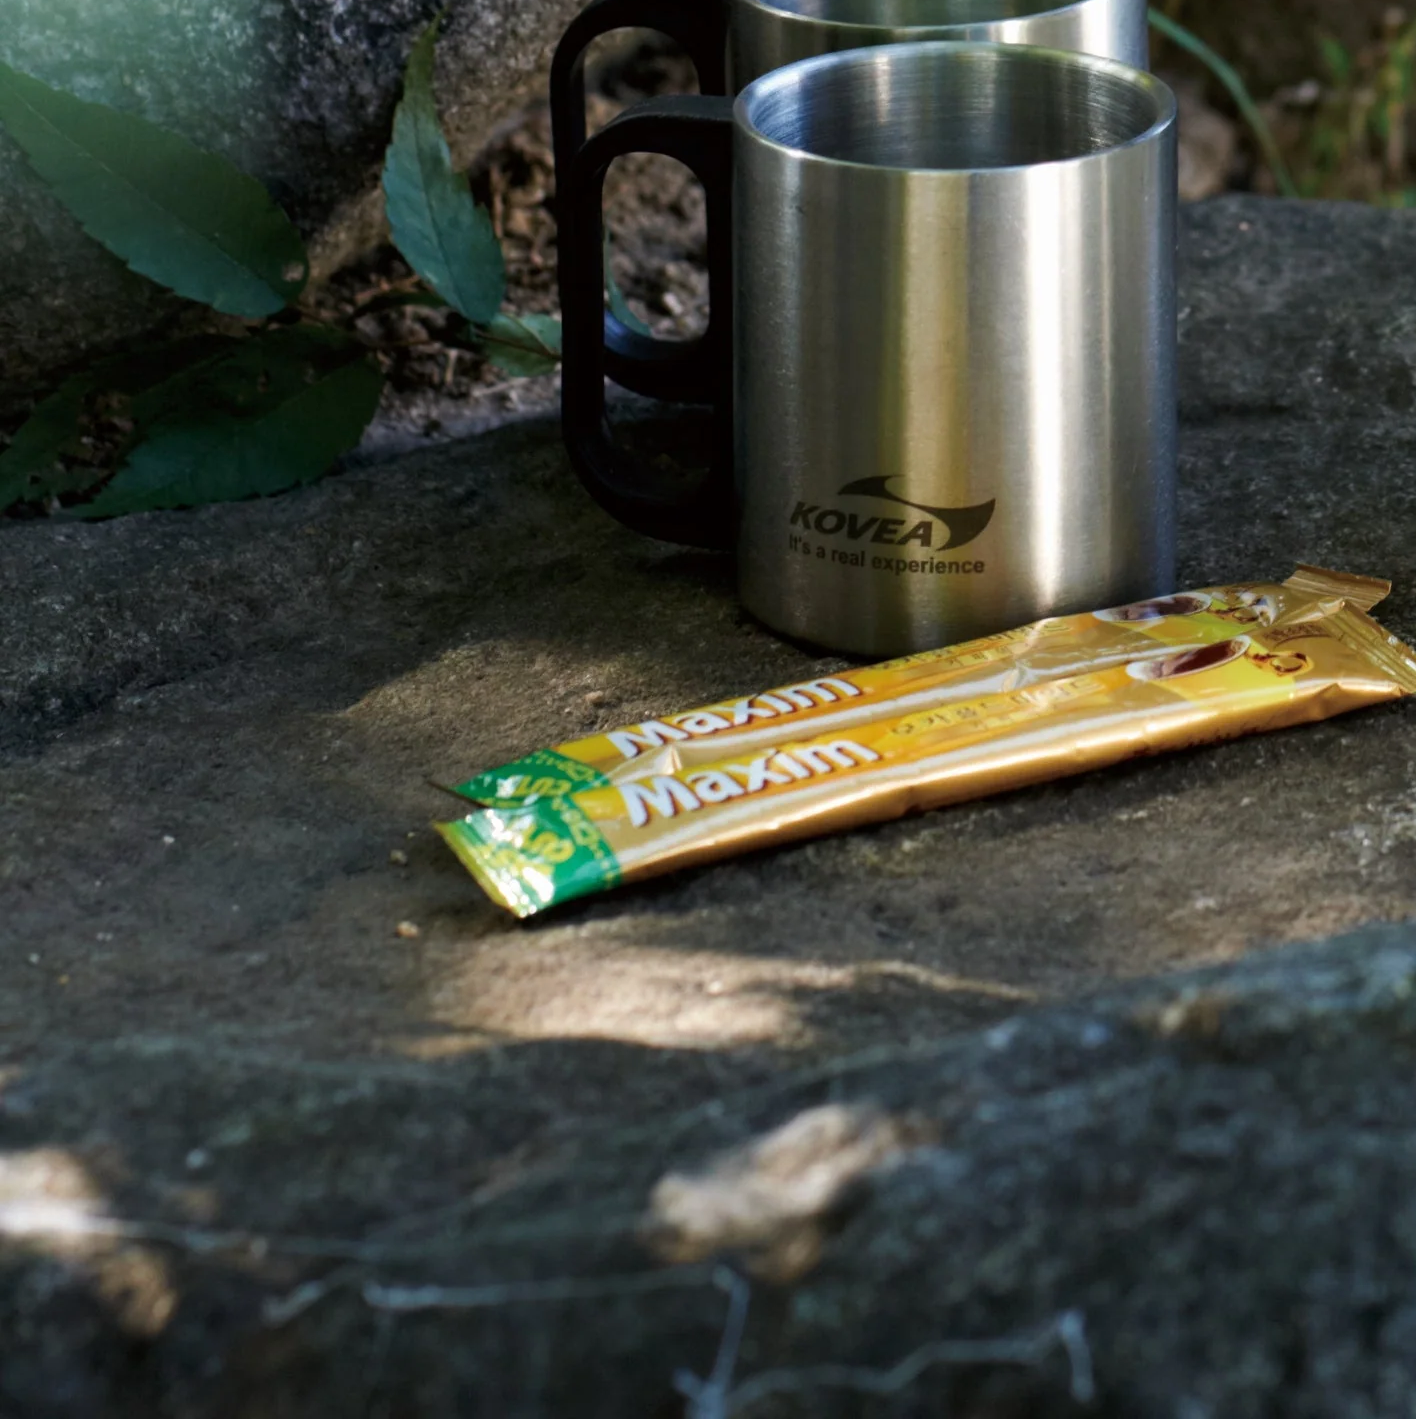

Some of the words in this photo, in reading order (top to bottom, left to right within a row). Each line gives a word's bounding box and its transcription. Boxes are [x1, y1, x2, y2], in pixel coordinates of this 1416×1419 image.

[788, 533, 812, 556] It's
[815, 545, 827, 559] a
[831, 547, 865, 568] real
[870, 556, 986, 576] experience
[789, 500, 933, 548] KOVEA
[606, 677, 864, 760] Maxim
[618, 739, 883, 829] Maxim
